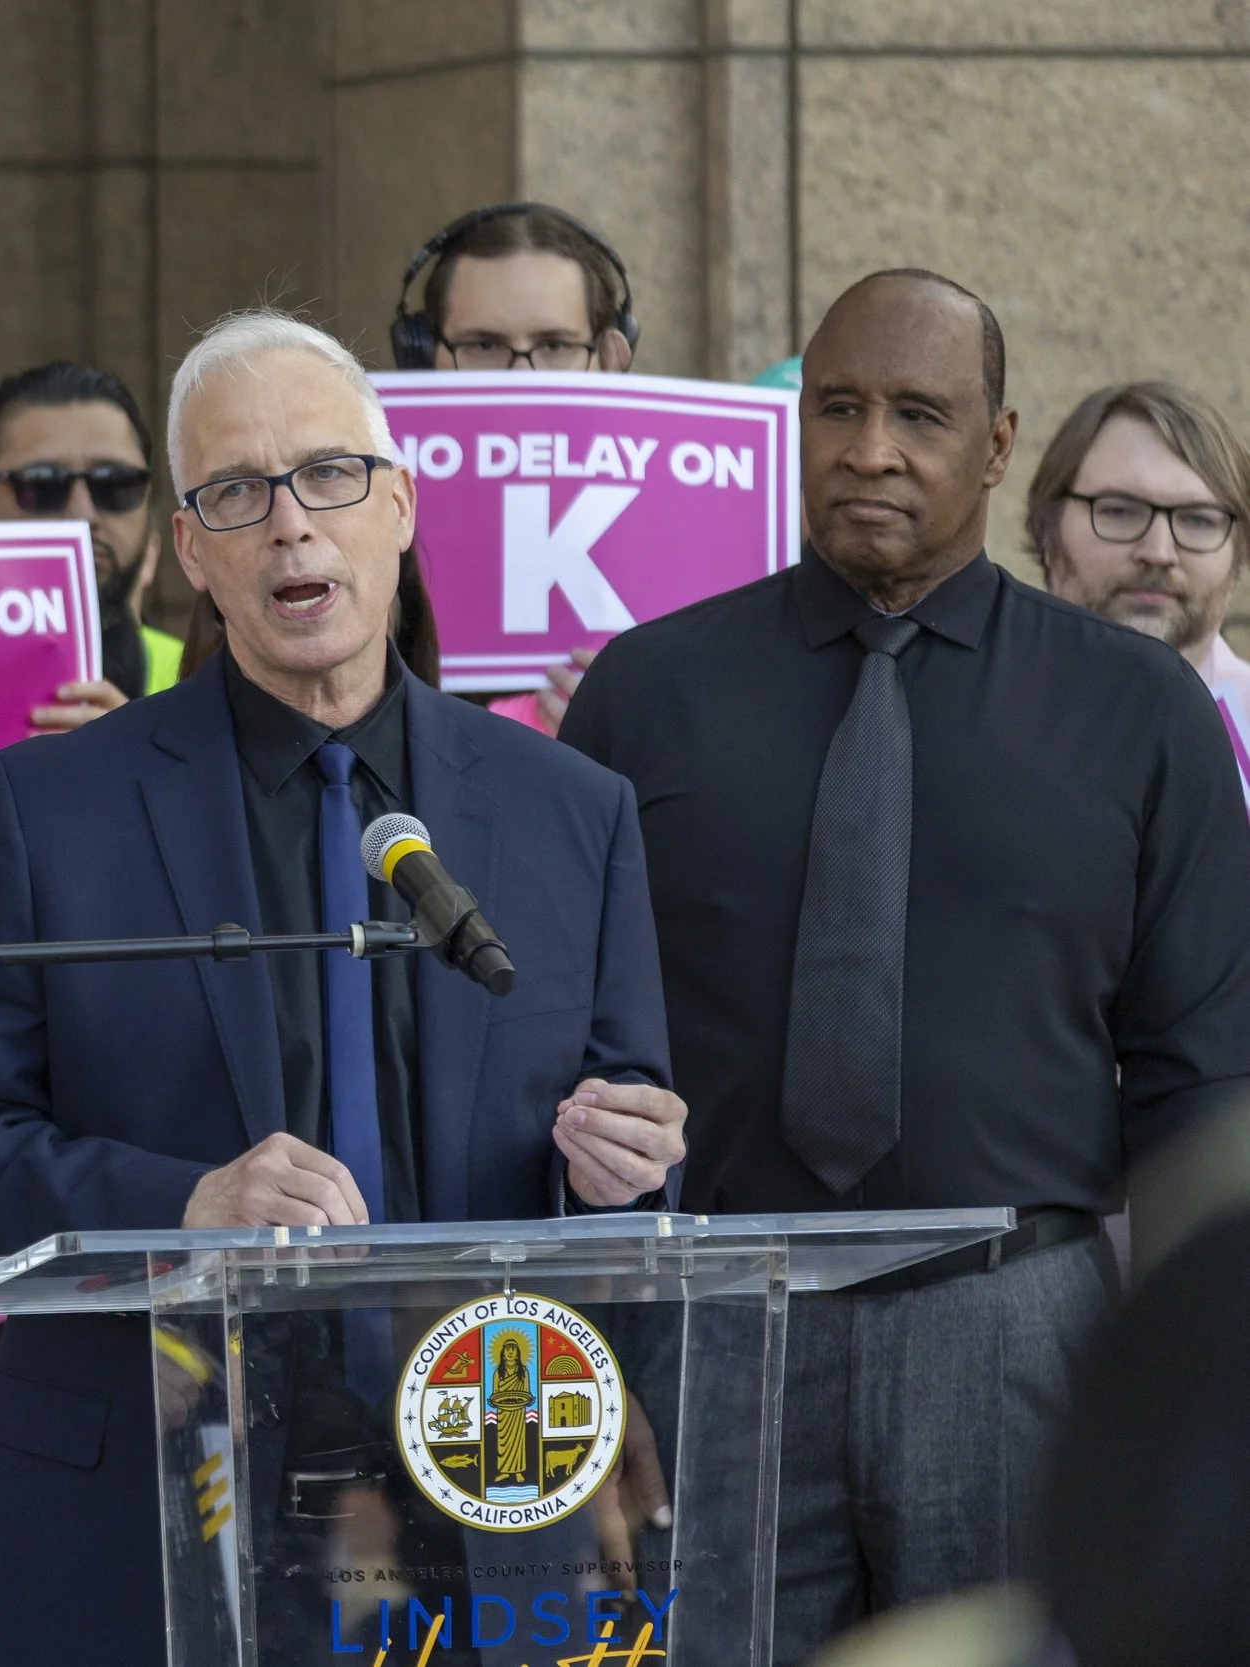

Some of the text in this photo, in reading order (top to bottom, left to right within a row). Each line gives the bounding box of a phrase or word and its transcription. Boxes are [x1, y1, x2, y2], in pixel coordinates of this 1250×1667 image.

[393, 434, 754, 490] NO DELAY ON
[502, 483, 641, 634] K
[413, 1299, 610, 1376] COUNTY OF LOS ANGELES
[459, 1496, 568, 1524] CALIFORNIA
[329, 1569, 366, 1583] LOS
[473, 1564, 551, 1579] COUNTY
[561, 1559, 684, 1576] SUPERVISOR
[331, 1587, 680, 1653] LINDSEY
